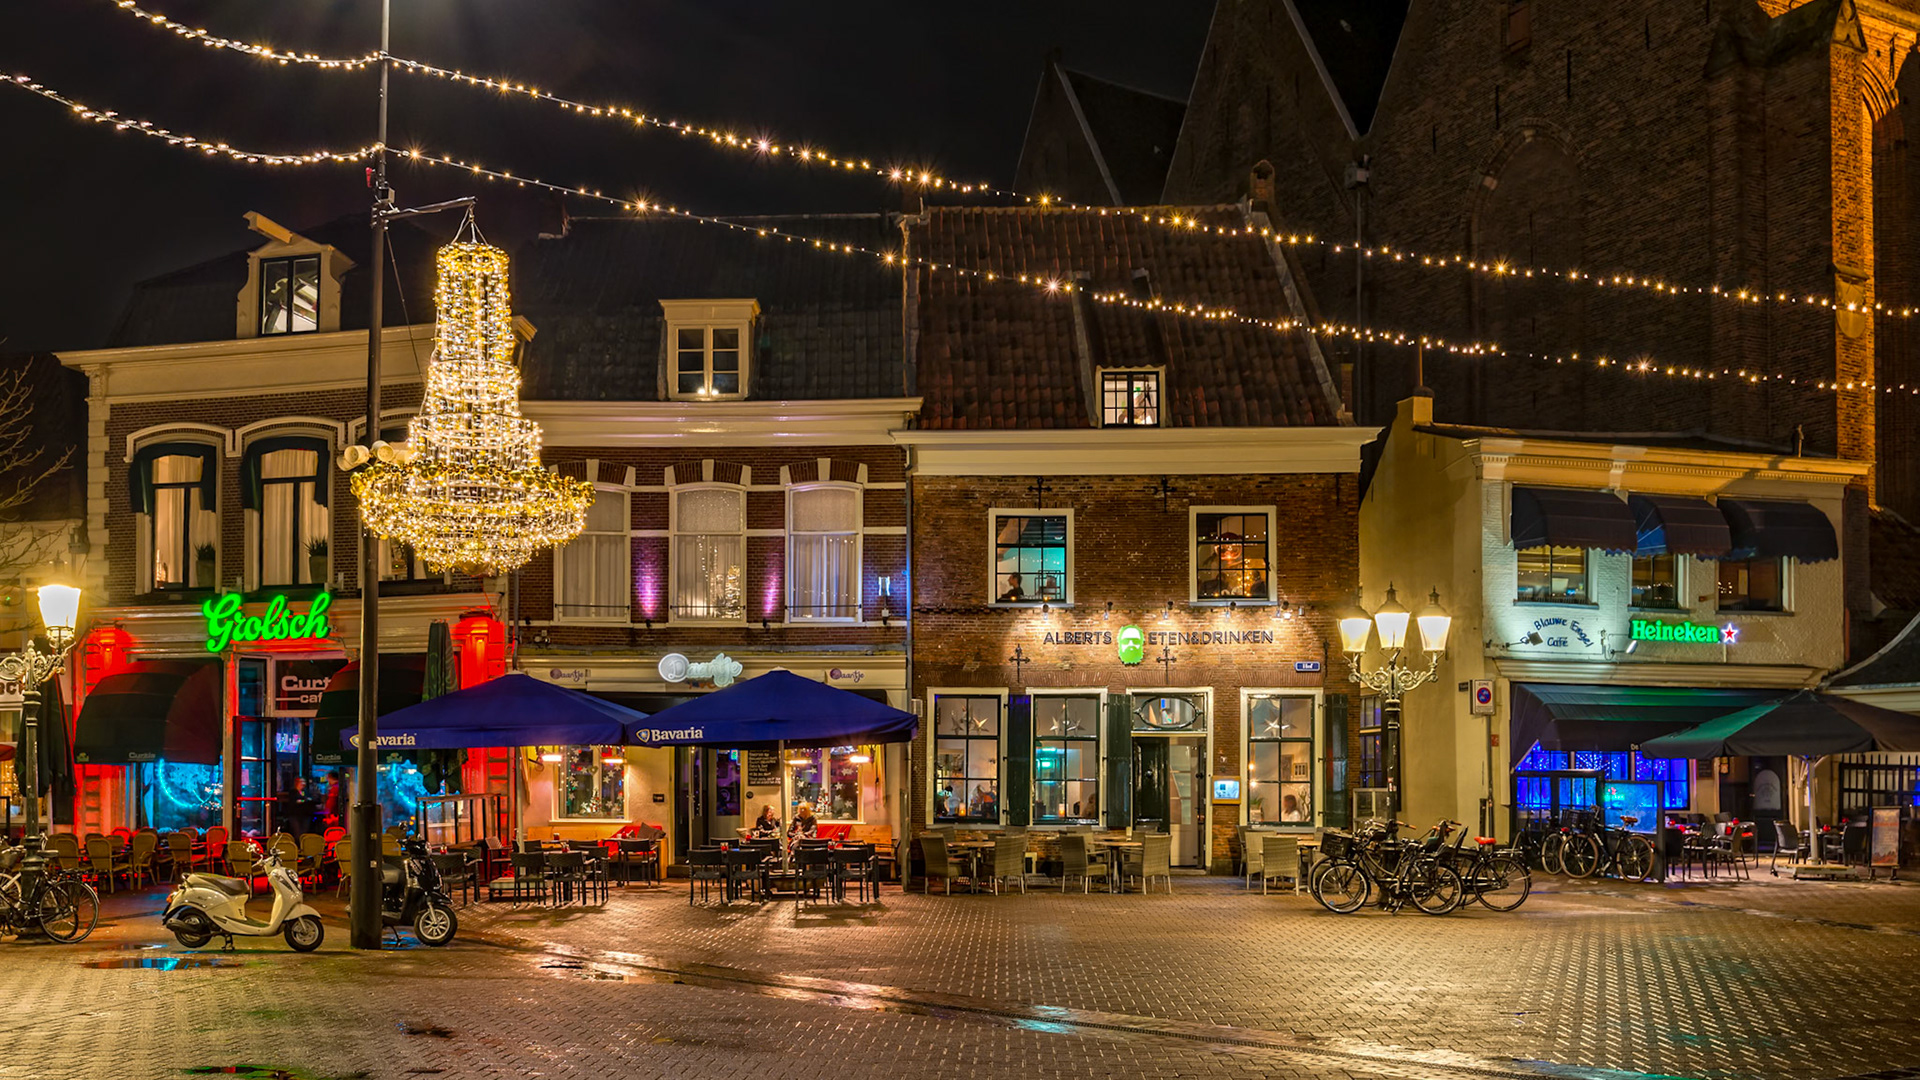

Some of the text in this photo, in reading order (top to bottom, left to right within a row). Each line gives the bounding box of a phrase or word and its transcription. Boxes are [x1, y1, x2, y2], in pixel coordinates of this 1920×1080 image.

[203, 592, 330, 652] Grolsch
[1043, 630, 1274, 645] ALBERTS ETEN&DRINKEN
[1533, 617, 1568, 631] Blauwe
[1569, 619, 1594, 648] Engel
[1631, 619, 1719, 643] Heineken
[1547, 636, 1569, 648] Café
[550, 668, 584, 683] aantje
[830, 668, 865, 683] aantje
[281, 675, 332, 692] Curt
[300, 692, 323, 704] caf
[376, 733, 416, 746] avaria
[651, 727, 704, 742] Bavaria
